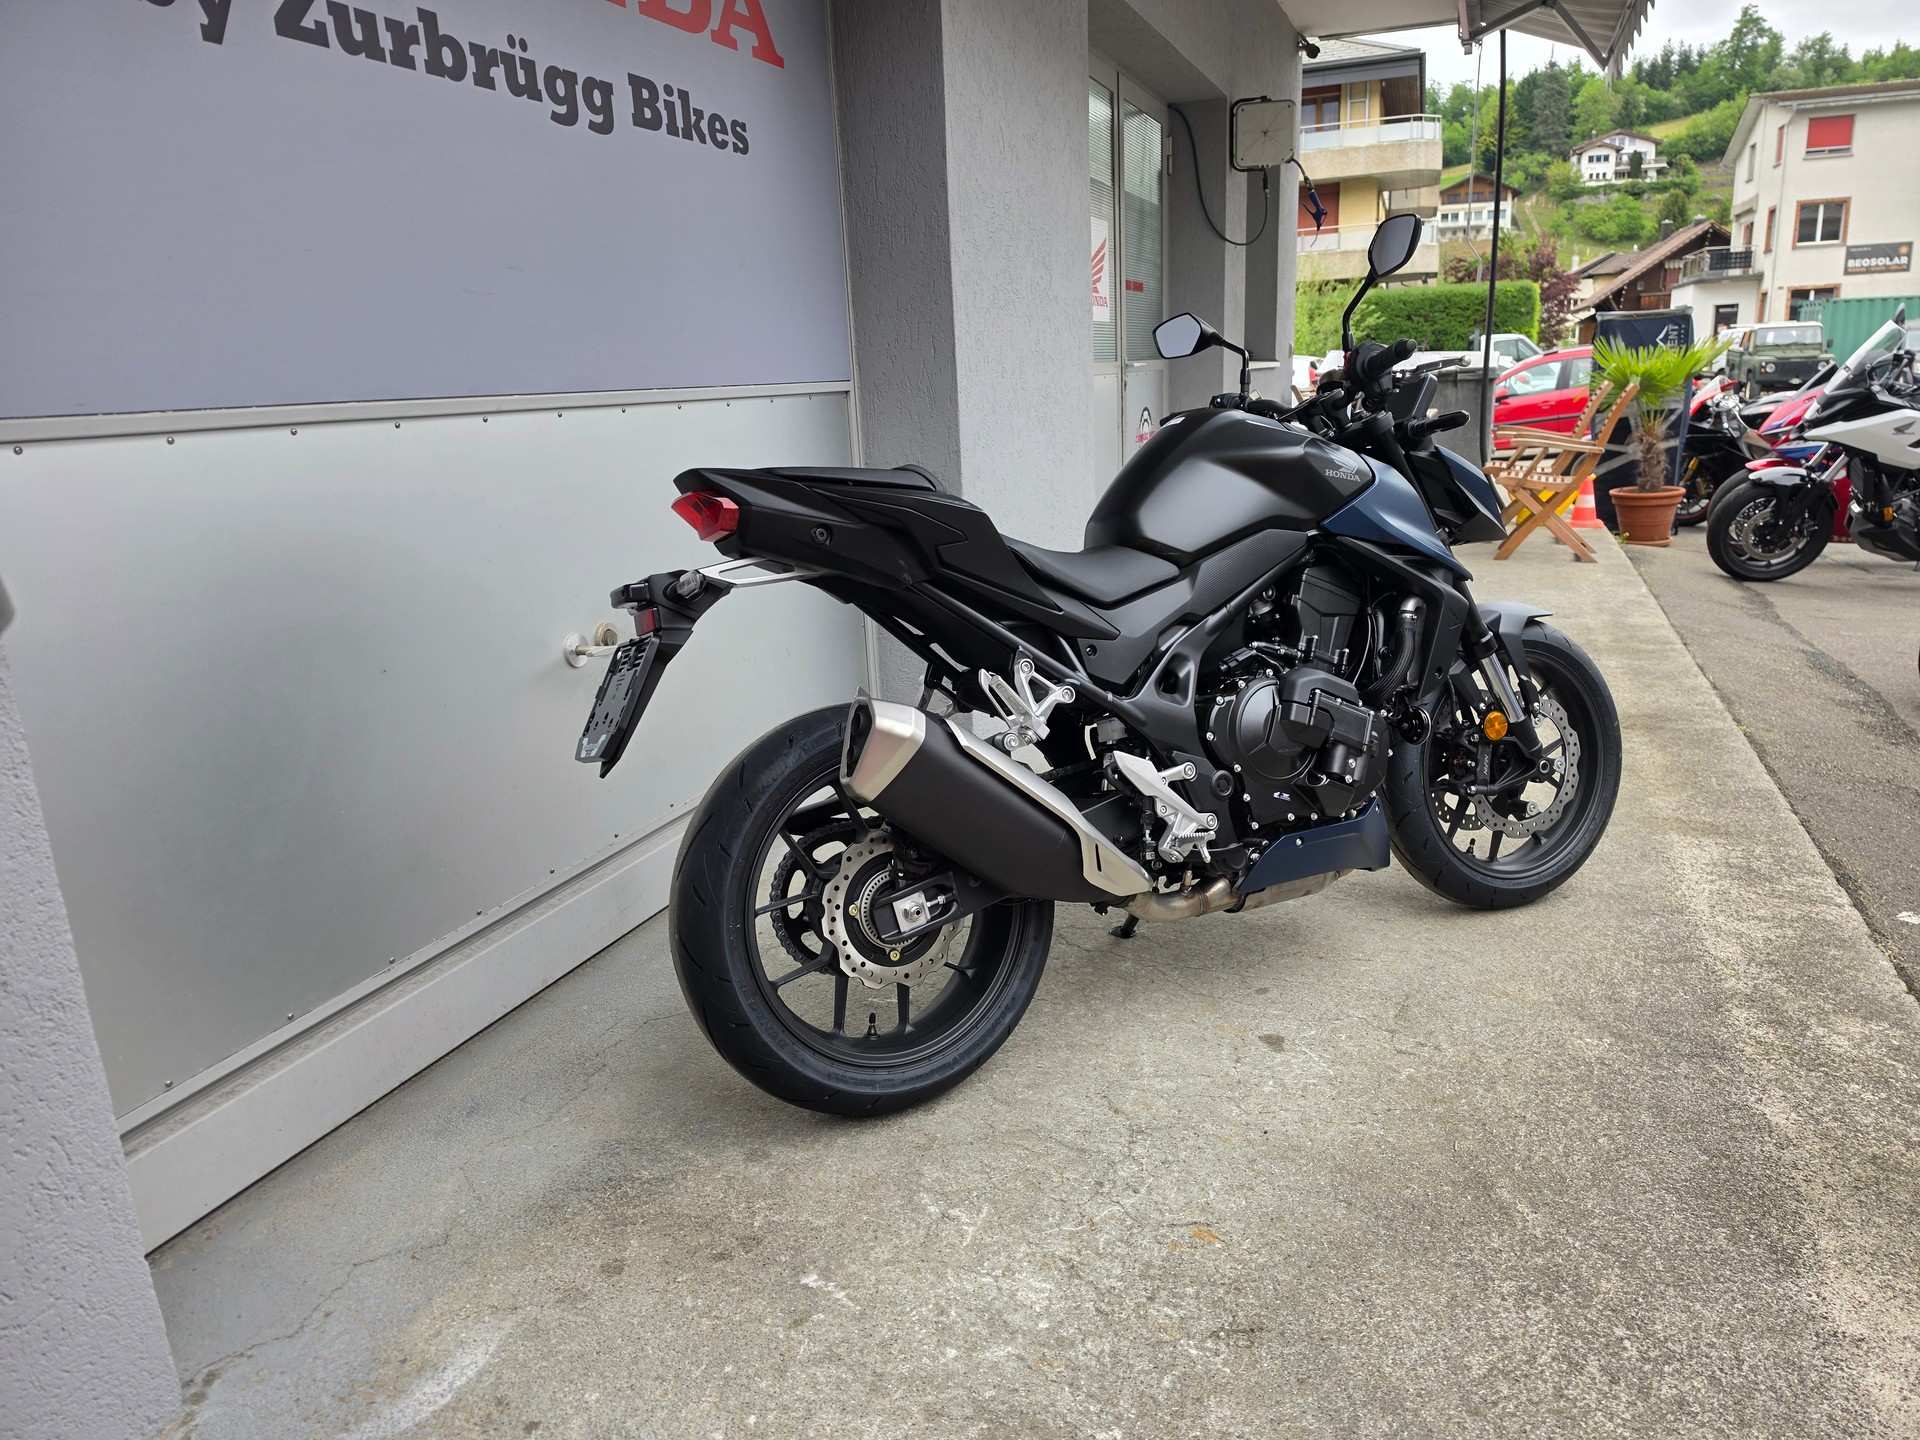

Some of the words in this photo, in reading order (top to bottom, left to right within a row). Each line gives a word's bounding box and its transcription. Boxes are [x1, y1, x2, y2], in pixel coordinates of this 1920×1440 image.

[273, 0, 614, 135] Zurbrügg
[627, 72, 750, 155] Bikes
[1847, 255, 1909, 268] BEOSOLAR
[1091, 294, 1108, 308] ONDA
[1325, 469, 1361, 482] HONDA
